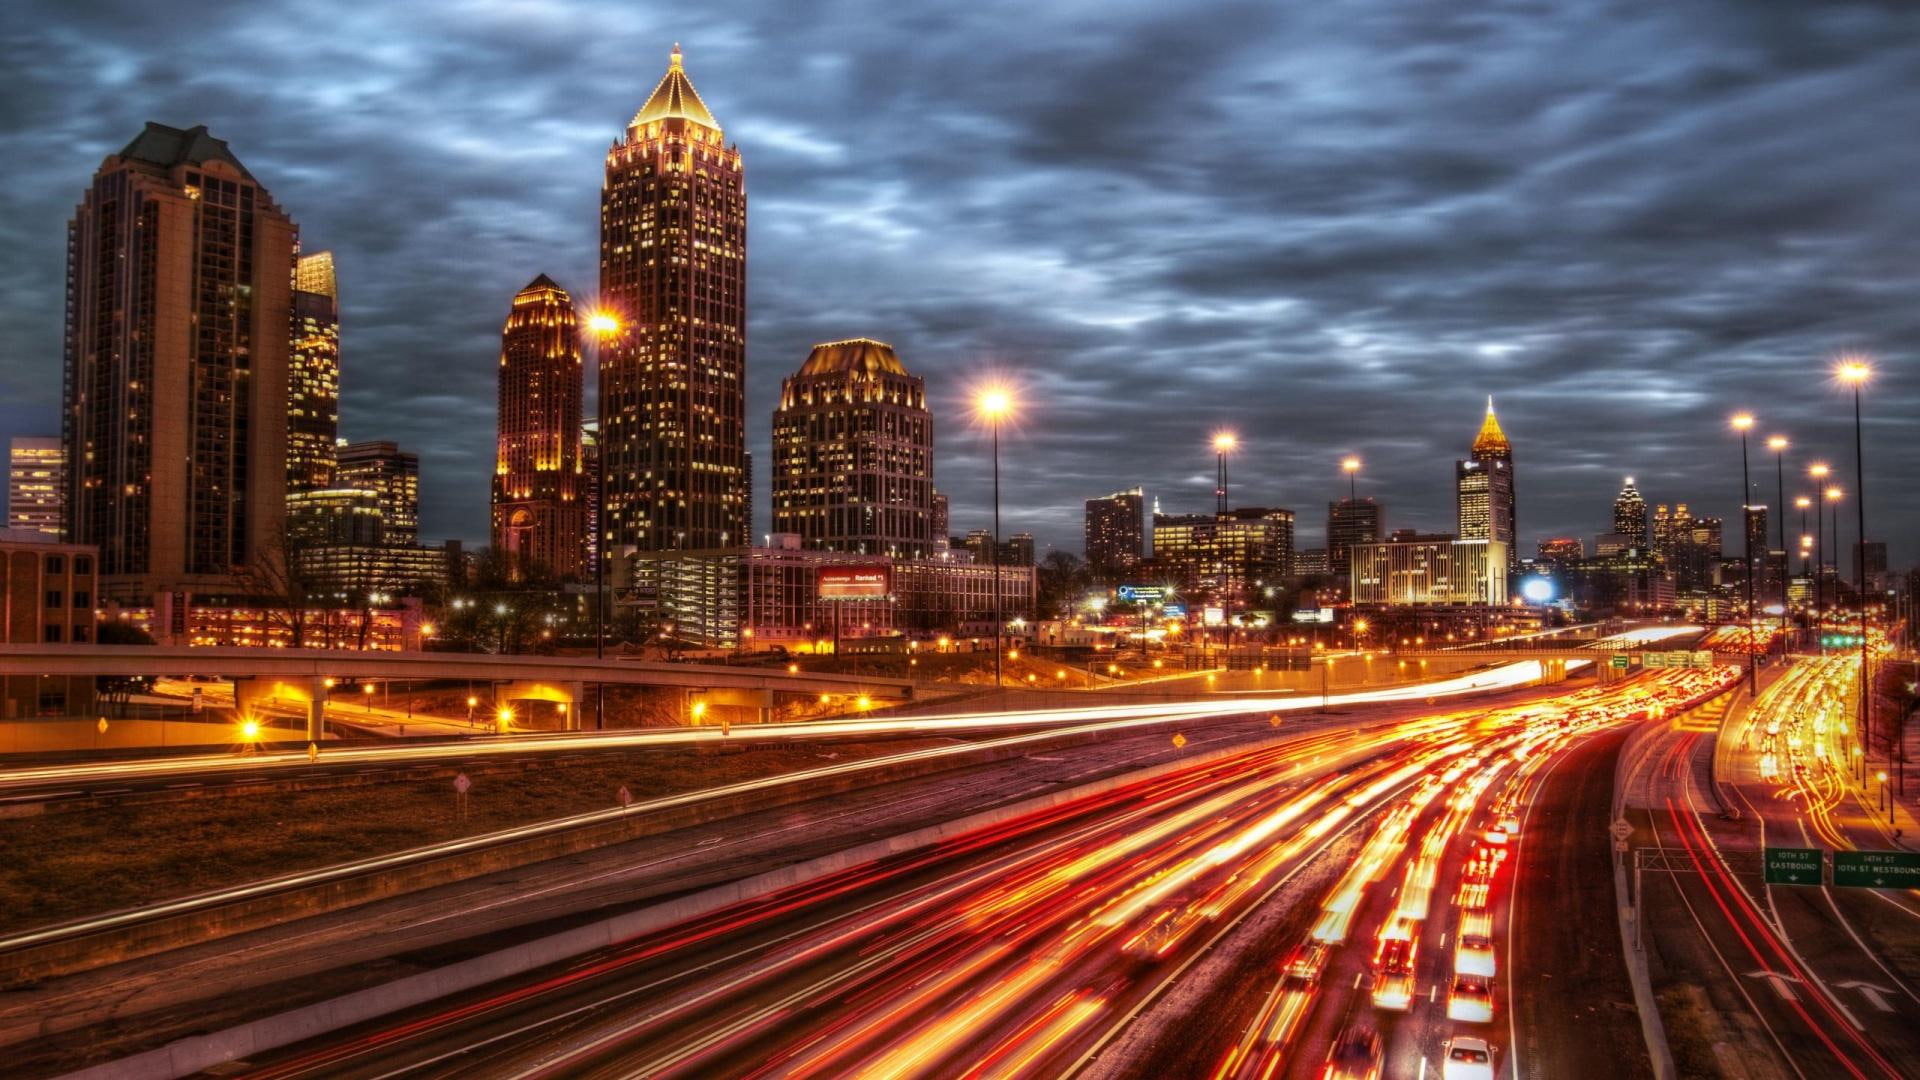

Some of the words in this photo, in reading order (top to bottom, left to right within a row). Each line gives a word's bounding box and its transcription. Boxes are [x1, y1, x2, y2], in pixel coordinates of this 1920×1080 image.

[1778, 852, 1797, 860] 10TH
[1799, 852, 1809, 860] ST
[1770, 861, 1817, 871] EASTBOUND
[1838, 864, 1856, 872] 10TH
[1859, 865, 1869, 873] ST
[1873, 866, 1920, 874] WESTBOUND
